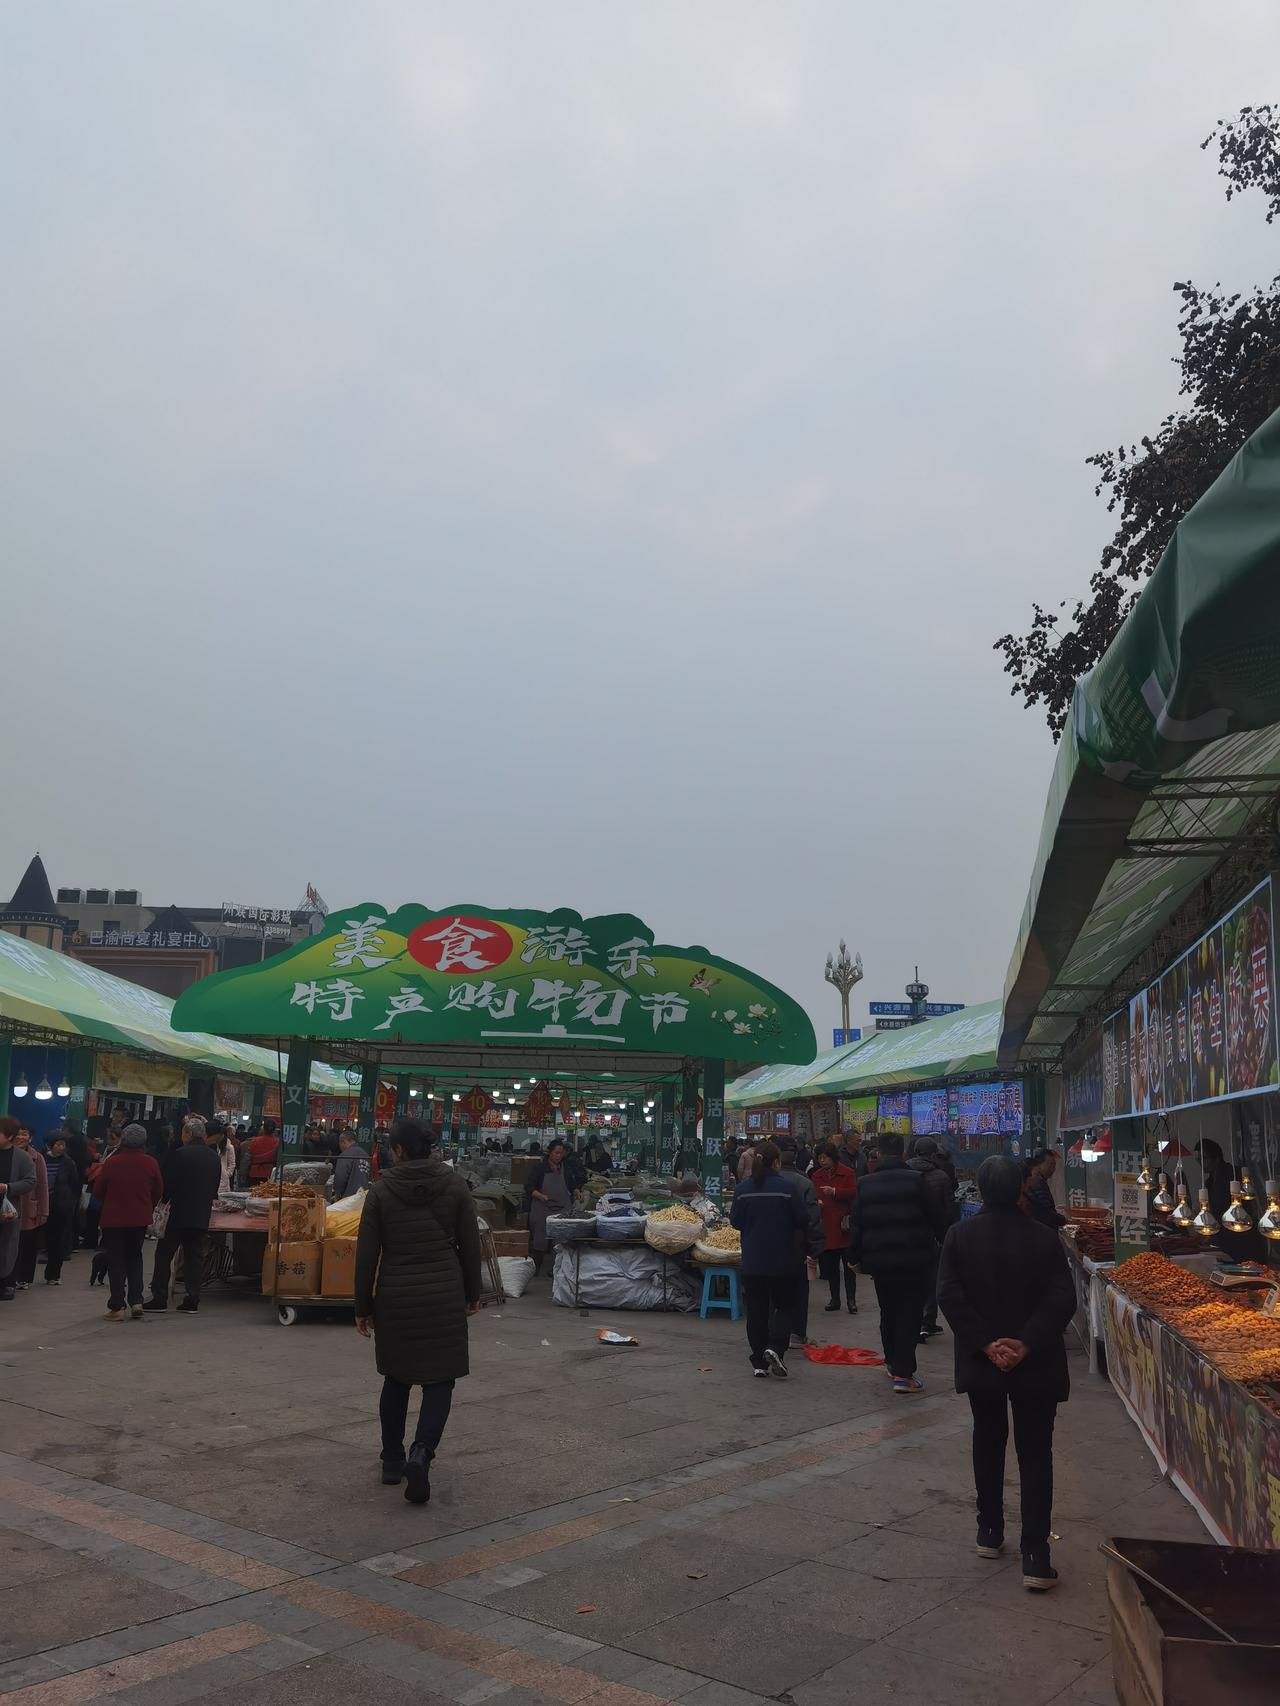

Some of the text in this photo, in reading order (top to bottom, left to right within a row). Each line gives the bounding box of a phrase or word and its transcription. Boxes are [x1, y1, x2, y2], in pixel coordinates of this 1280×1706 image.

[328, 914, 657, 978] 美食游乐
[290, 978, 690, 1035] 特产购物节
[283, 1085, 302, 1145] 文明
